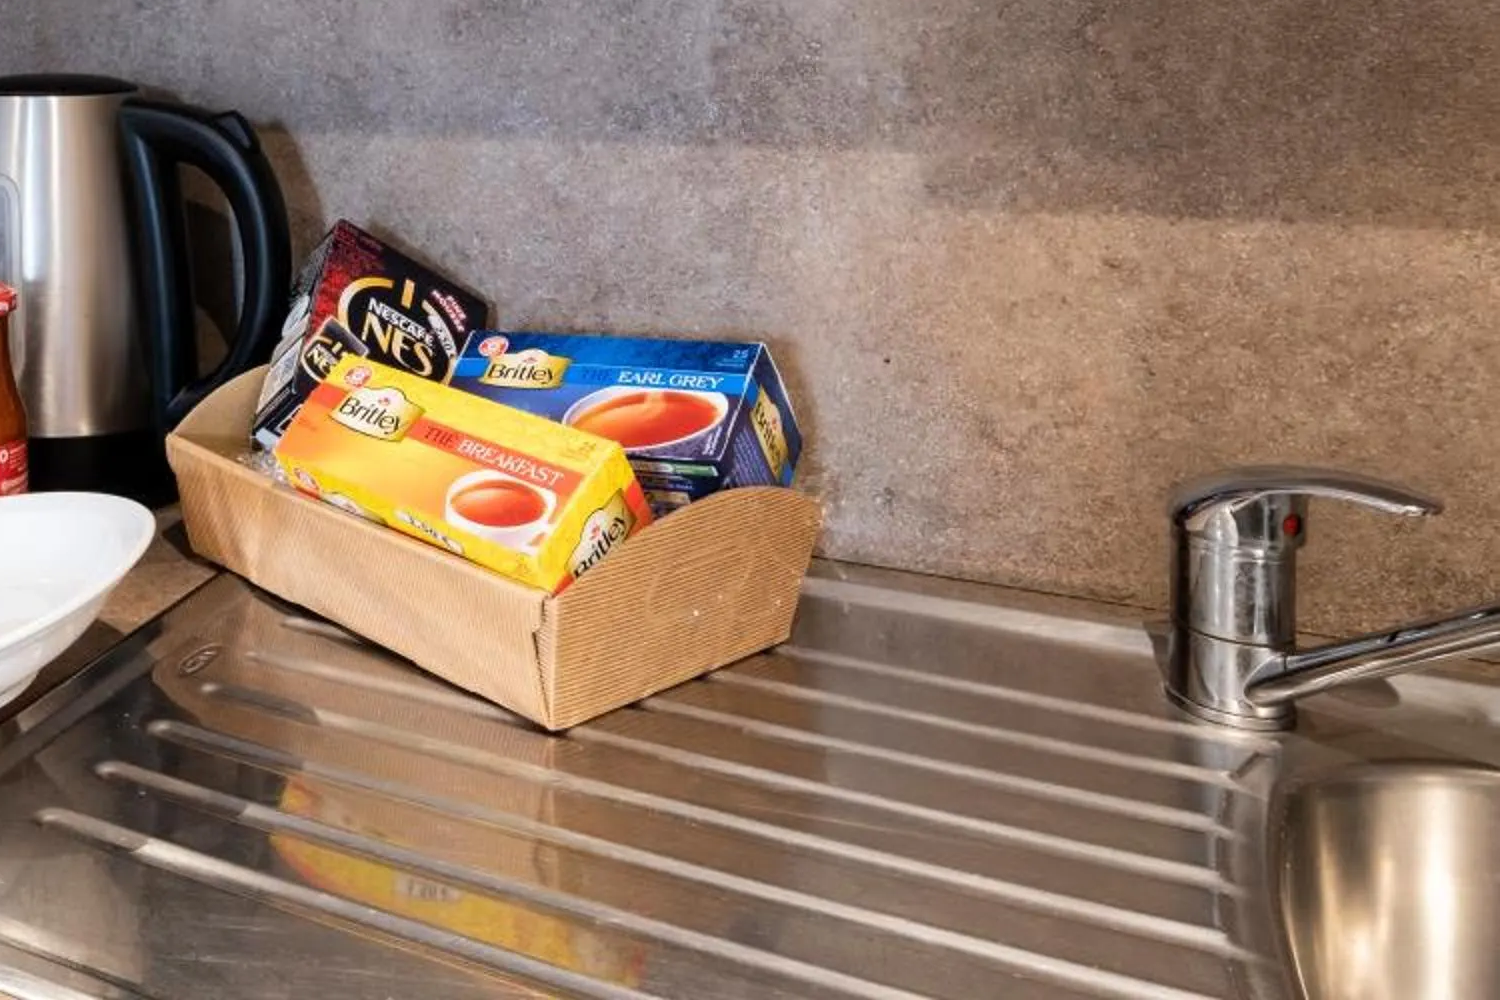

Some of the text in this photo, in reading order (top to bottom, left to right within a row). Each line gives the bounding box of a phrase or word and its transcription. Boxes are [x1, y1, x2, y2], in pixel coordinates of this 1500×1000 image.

[361, 311, 432, 377] NES
[487, 363, 553, 384] Britley
[618, 370, 666, 385] EARL
[668, 374, 724, 389] GREY
[340, 396, 400, 435] Britley
[458, 439, 564, 487] BREAKFAST
